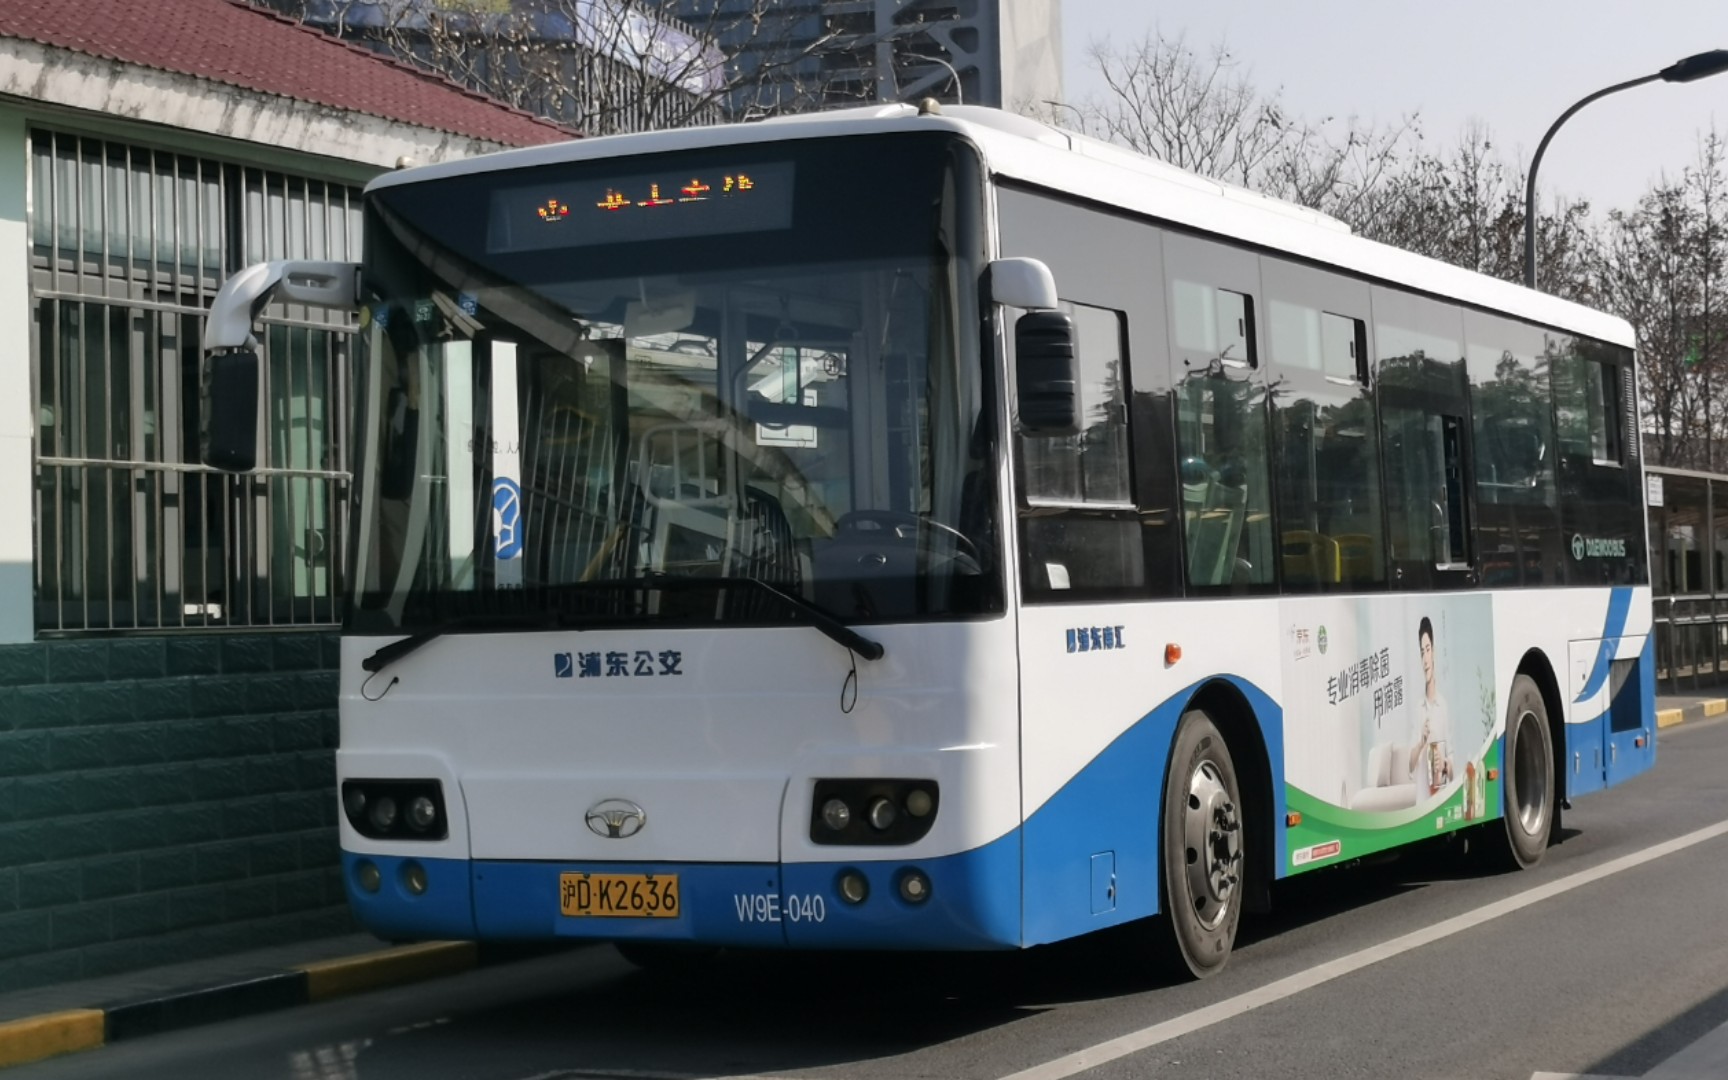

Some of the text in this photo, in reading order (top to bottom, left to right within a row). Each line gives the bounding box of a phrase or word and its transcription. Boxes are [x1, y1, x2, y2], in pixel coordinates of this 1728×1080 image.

[578, 650, 683, 678] 浦东公交
[1327, 647, 1389, 706] 专业消毒除菌
[1373, 675, 1403, 729] 用滴露
[733, 894, 825, 922] W9E-040
